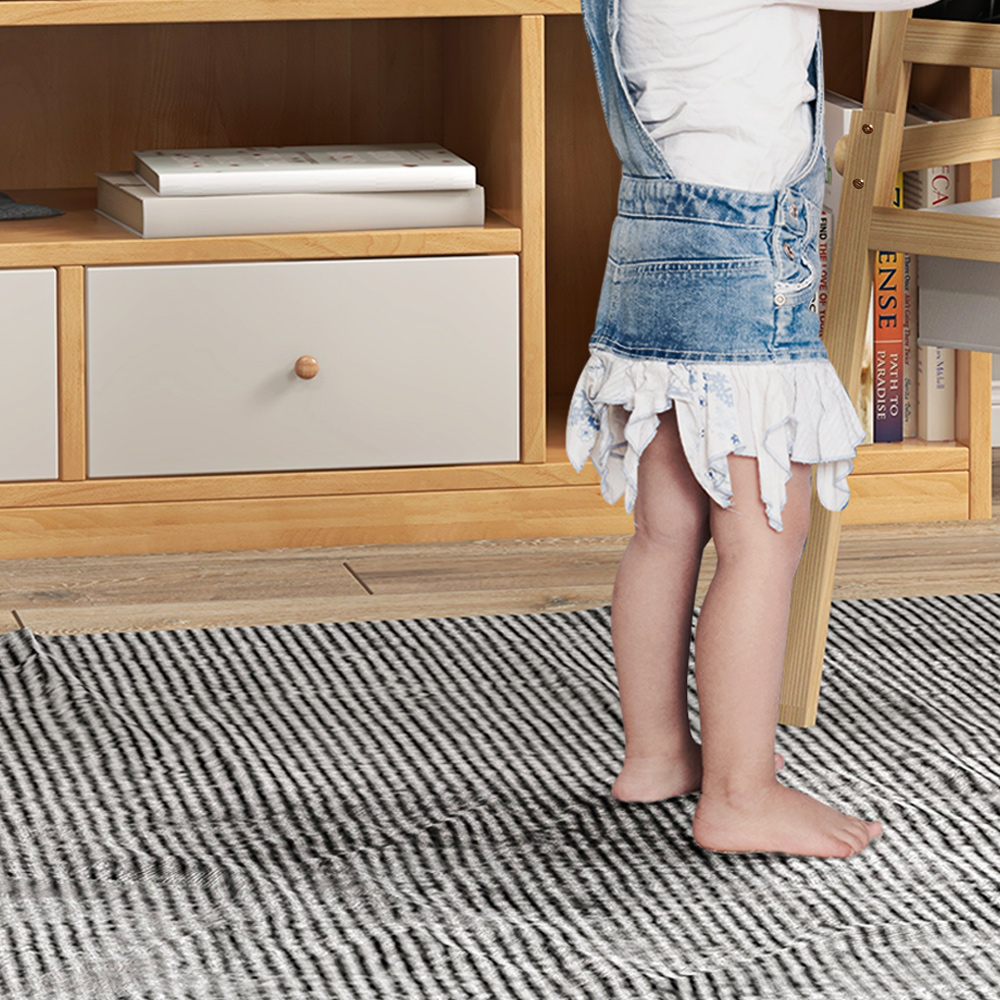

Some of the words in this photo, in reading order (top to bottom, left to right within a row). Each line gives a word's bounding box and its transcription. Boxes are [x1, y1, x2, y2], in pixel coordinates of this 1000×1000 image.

[819, 217, 828, 240] FIND
[819, 242, 828, 261] THE
[889, 353, 899, 391] PATH
[876, 351, 887, 420] PARADISE
[889, 395, 899, 417] TO
